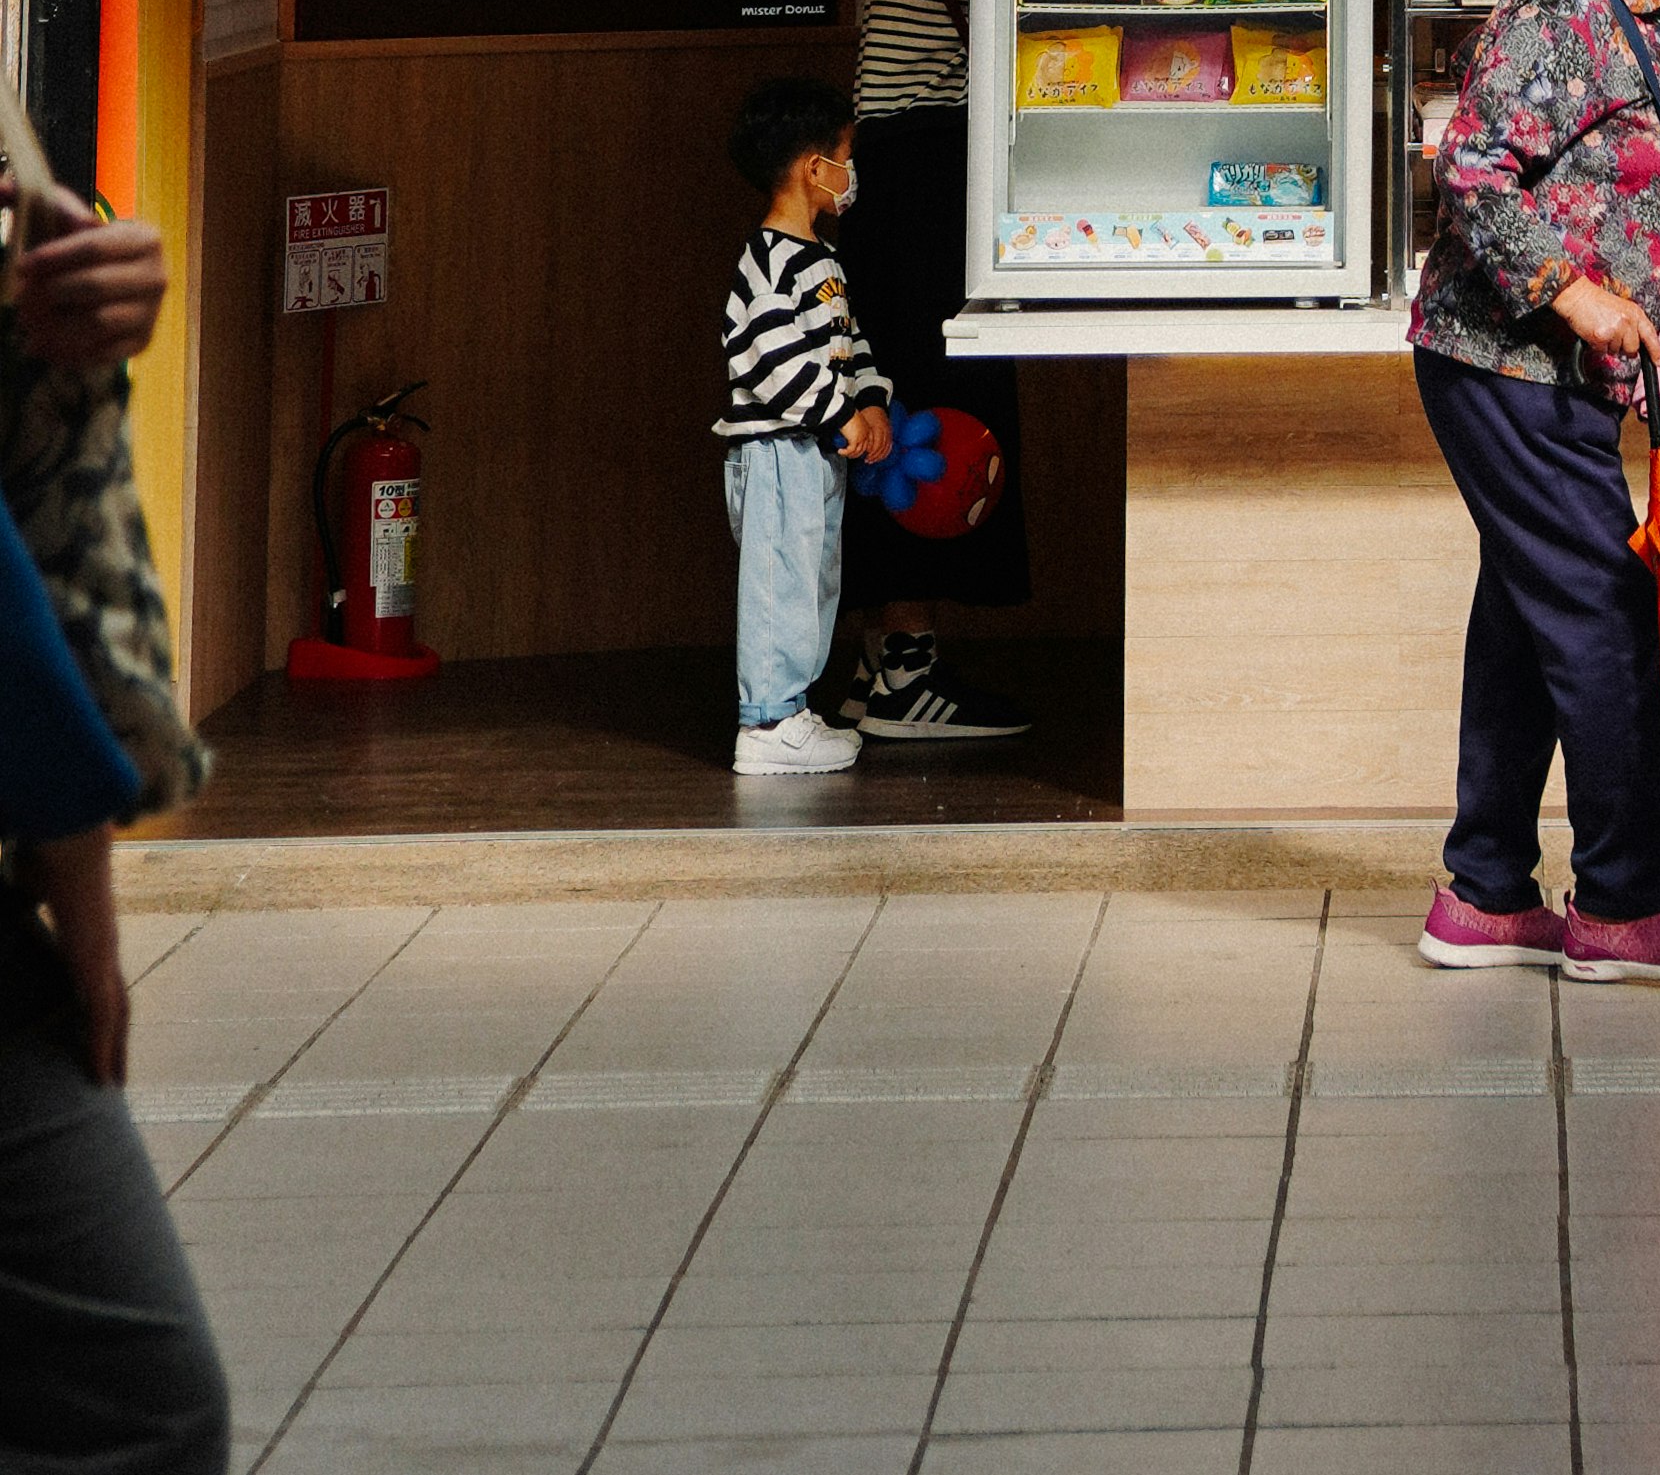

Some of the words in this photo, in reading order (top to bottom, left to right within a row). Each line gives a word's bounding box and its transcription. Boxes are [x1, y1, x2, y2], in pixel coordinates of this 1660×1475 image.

[785, 4, 826, 14] Donut
[294, 195, 365, 227] 滅火器
[294, 229, 310, 238] FIRE
